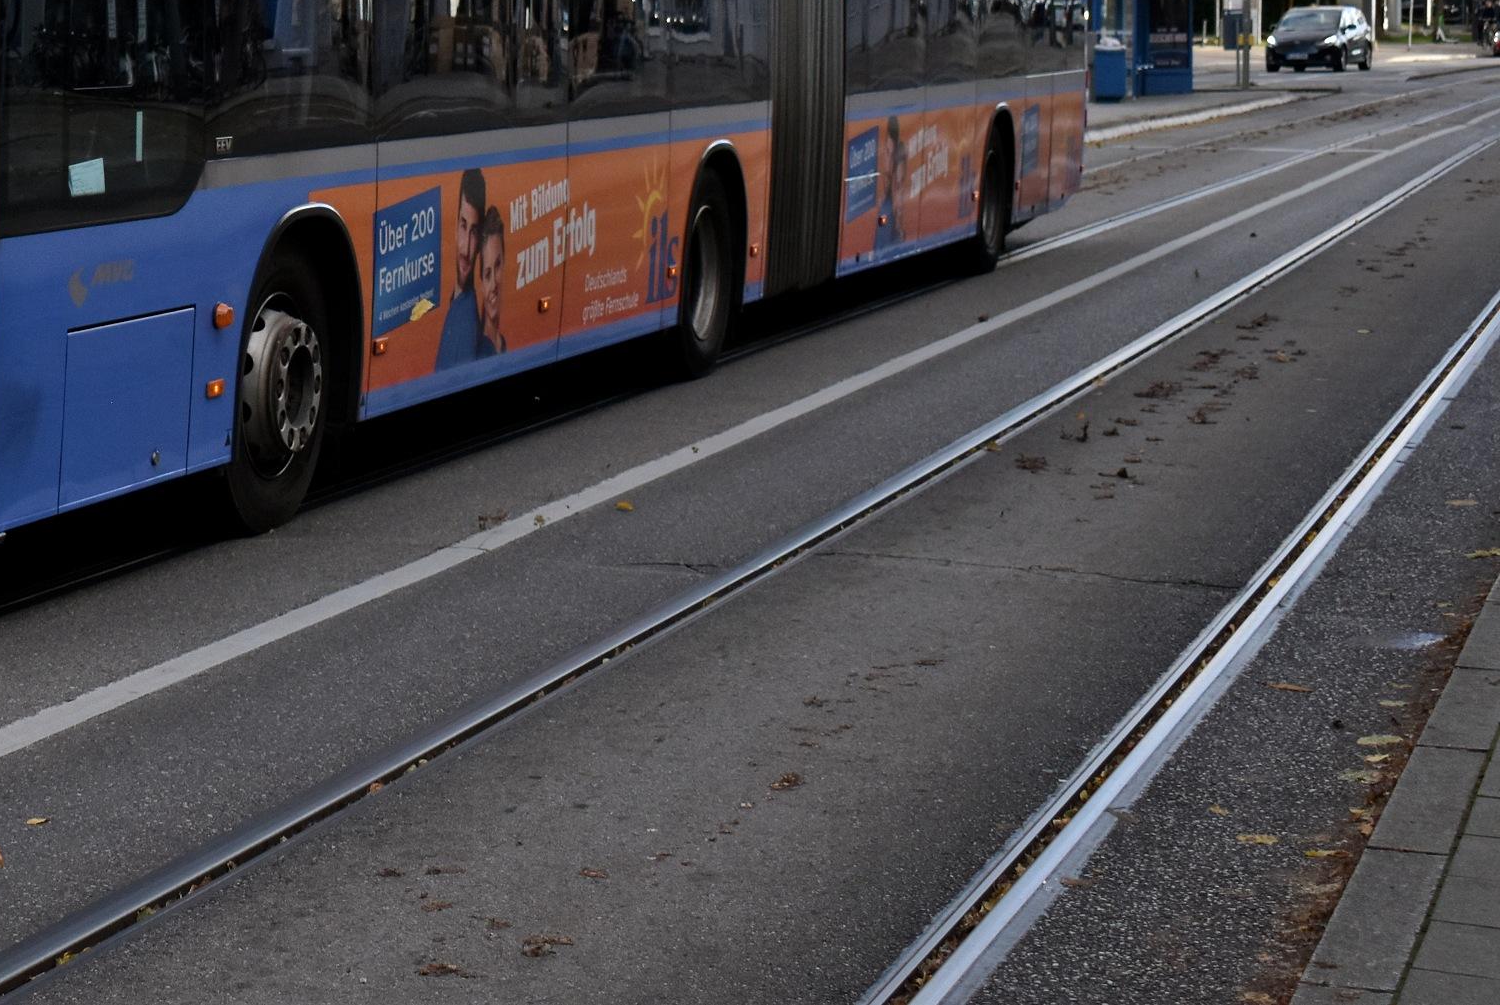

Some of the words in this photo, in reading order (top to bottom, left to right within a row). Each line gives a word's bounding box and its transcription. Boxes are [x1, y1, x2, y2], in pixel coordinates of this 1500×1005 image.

[510, 193, 528, 234] Mit
[531, 178, 570, 222] Bildung
[379, 219, 409, 256] Über
[411, 206, 436, 242] 200
[516, 236, 550, 291] zum
[553, 201, 597, 268] Erfolg
[379, 251, 436, 296] Fernkurse
[584, 267, 628, 293] Deutschlands
[582, 299, 605, 325] größte
[605, 290, 640, 315] Fernschule
